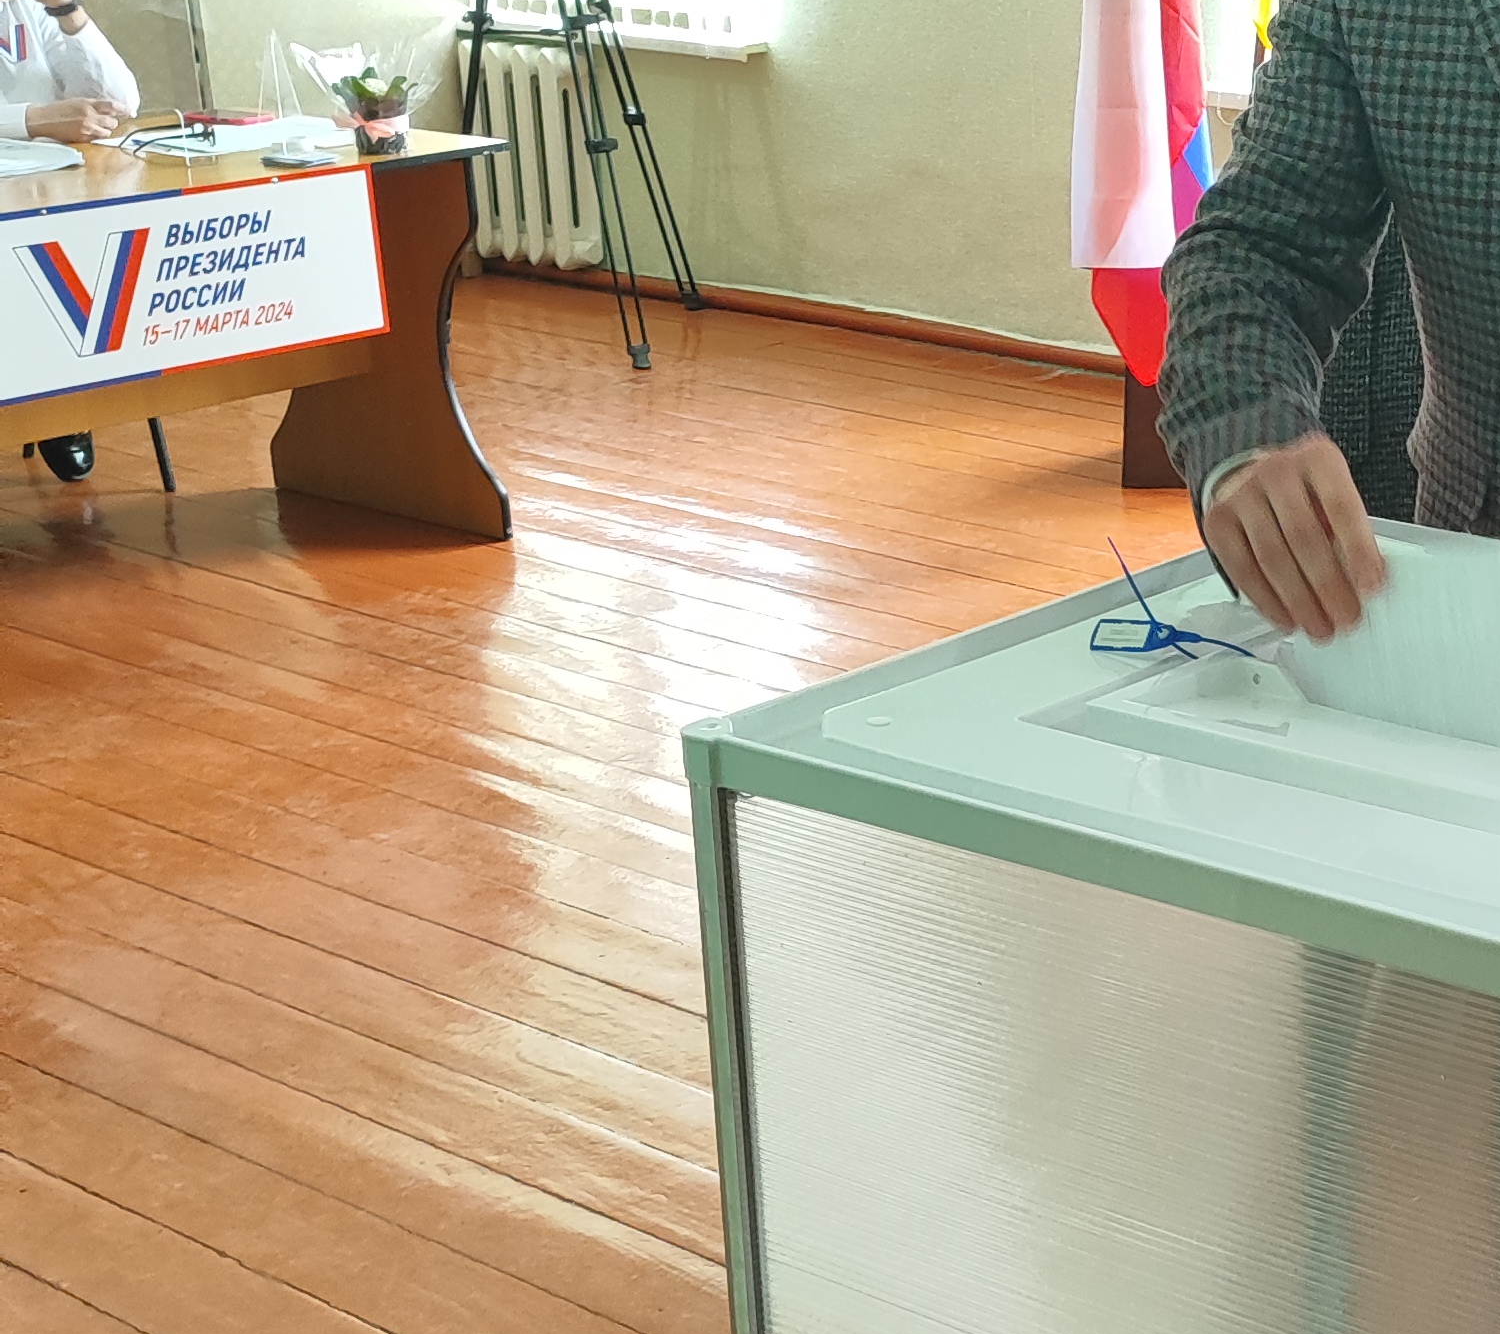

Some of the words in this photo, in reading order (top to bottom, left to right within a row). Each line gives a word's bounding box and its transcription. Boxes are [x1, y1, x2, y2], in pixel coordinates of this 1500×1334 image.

[164, 209, 271, 249] ВЫБОРЫ
[156, 236, 306, 283] ПРЕЗИДЕНТА
[147, 278, 246, 317] РОССИИ
[193, 308, 250, 338] МАРТА
[254, 300, 294, 325] 2024
